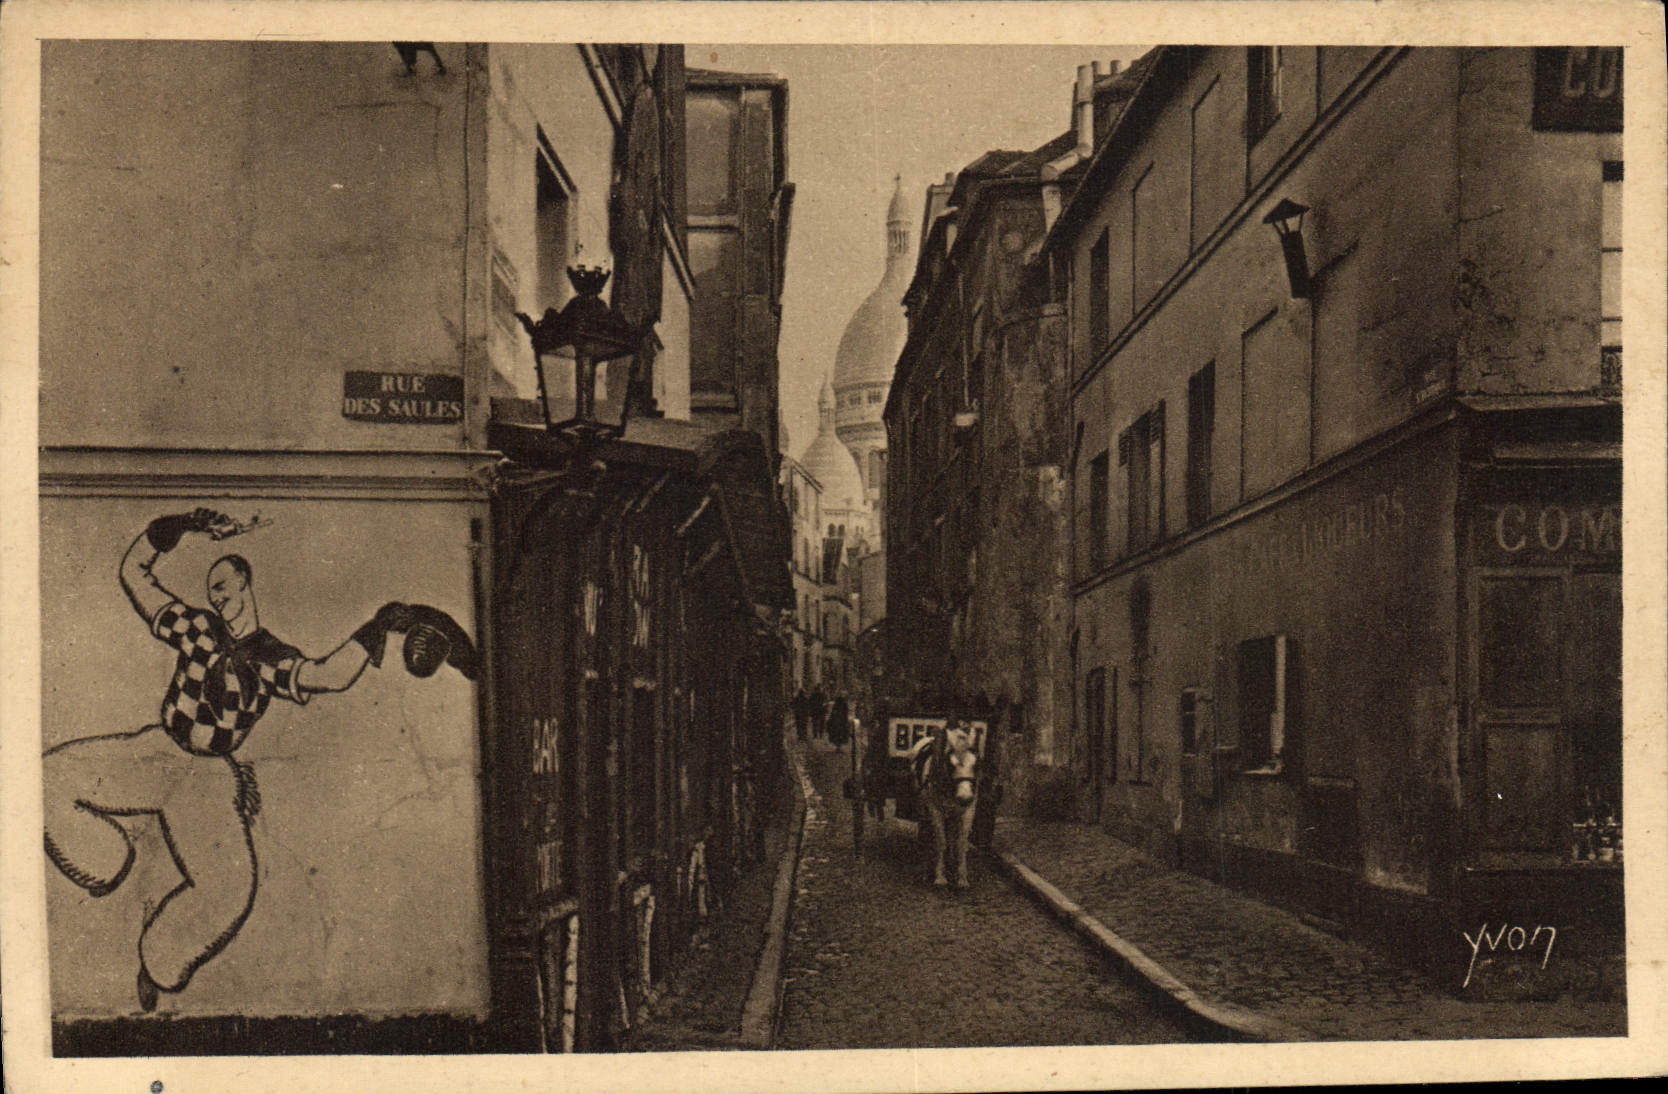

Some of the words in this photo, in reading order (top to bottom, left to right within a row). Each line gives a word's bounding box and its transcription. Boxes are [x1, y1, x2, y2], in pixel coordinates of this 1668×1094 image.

[381, 375, 426, 393] RUE
[344, 398, 381, 415] DES
[388, 400, 462, 418] SAULES
